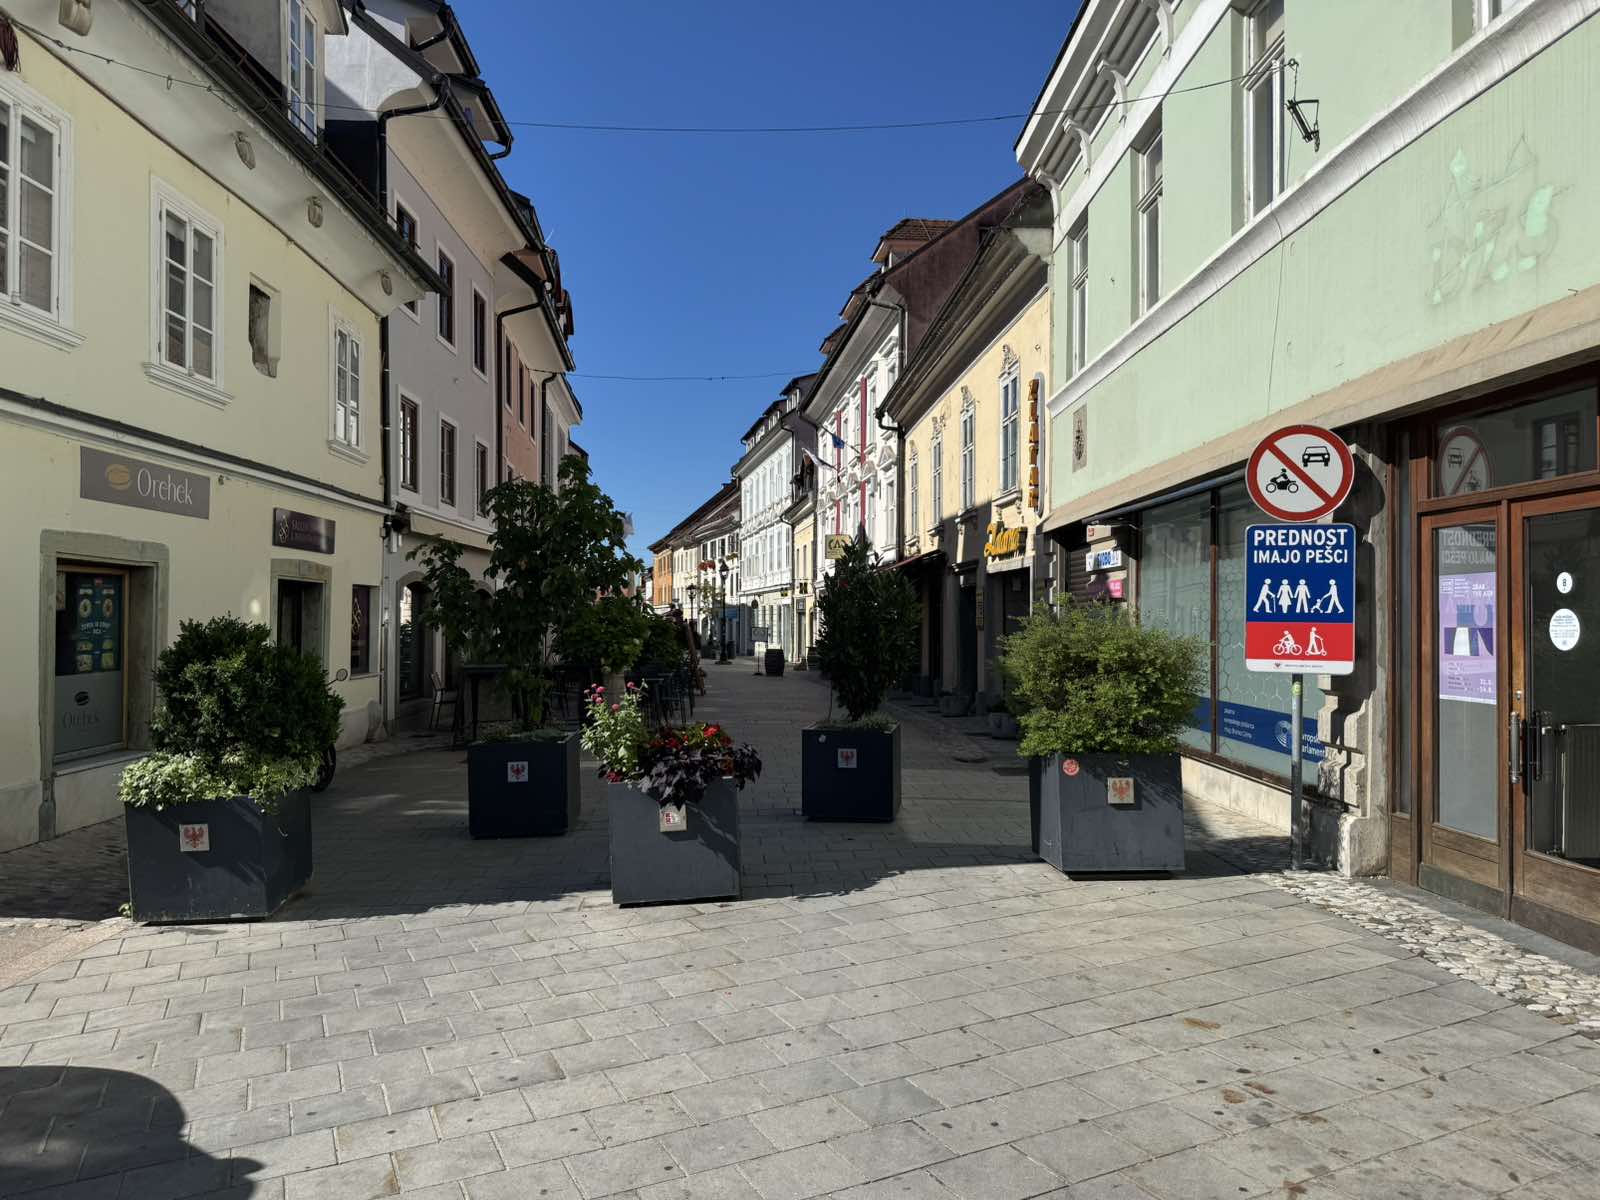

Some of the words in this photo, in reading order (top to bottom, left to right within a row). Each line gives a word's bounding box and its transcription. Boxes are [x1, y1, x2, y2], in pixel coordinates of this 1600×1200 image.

[137, 467, 193, 505] Orehek
[1253, 528, 1349, 547] PREDNOST
[1253, 550, 1301, 564] IMAJO
[1305, 545, 1348, 564] PEŠCI
